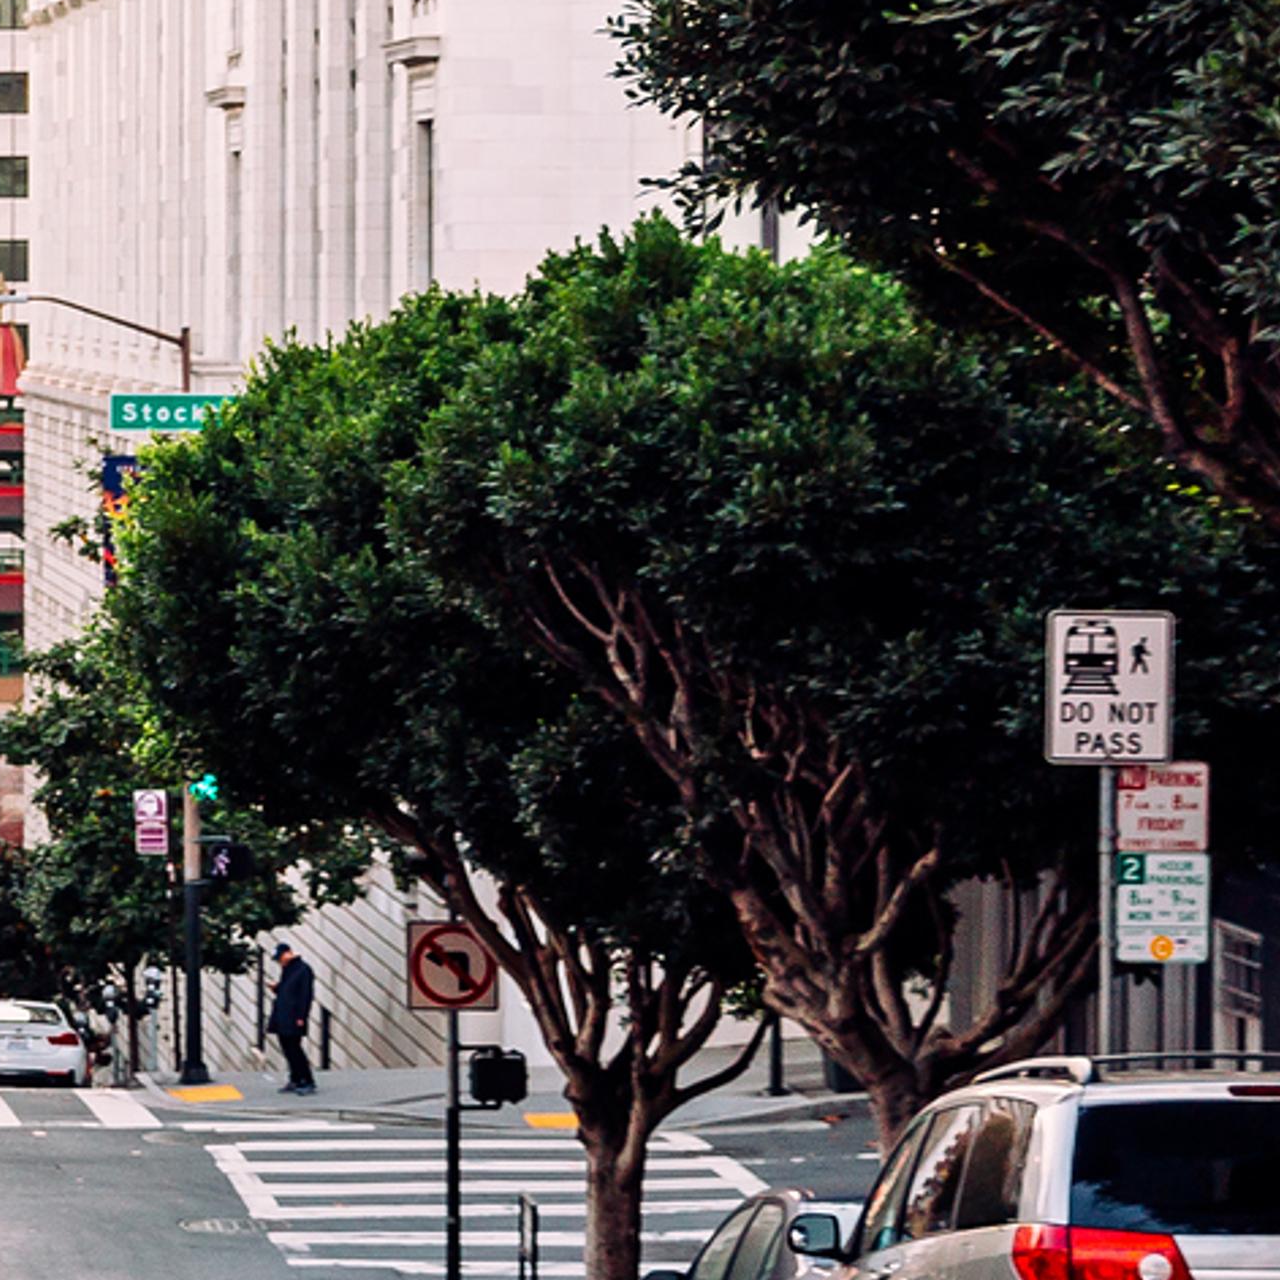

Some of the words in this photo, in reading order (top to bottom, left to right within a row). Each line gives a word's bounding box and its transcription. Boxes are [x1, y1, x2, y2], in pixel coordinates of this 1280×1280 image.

[1060, 702, 1094, 723] DO
[1108, 702, 1158, 724] NOT
[1075, 732, 1142, 754] PASS
[1150, 770, 1202, 788] PARKING
[1122, 857, 1141, 881] 2
